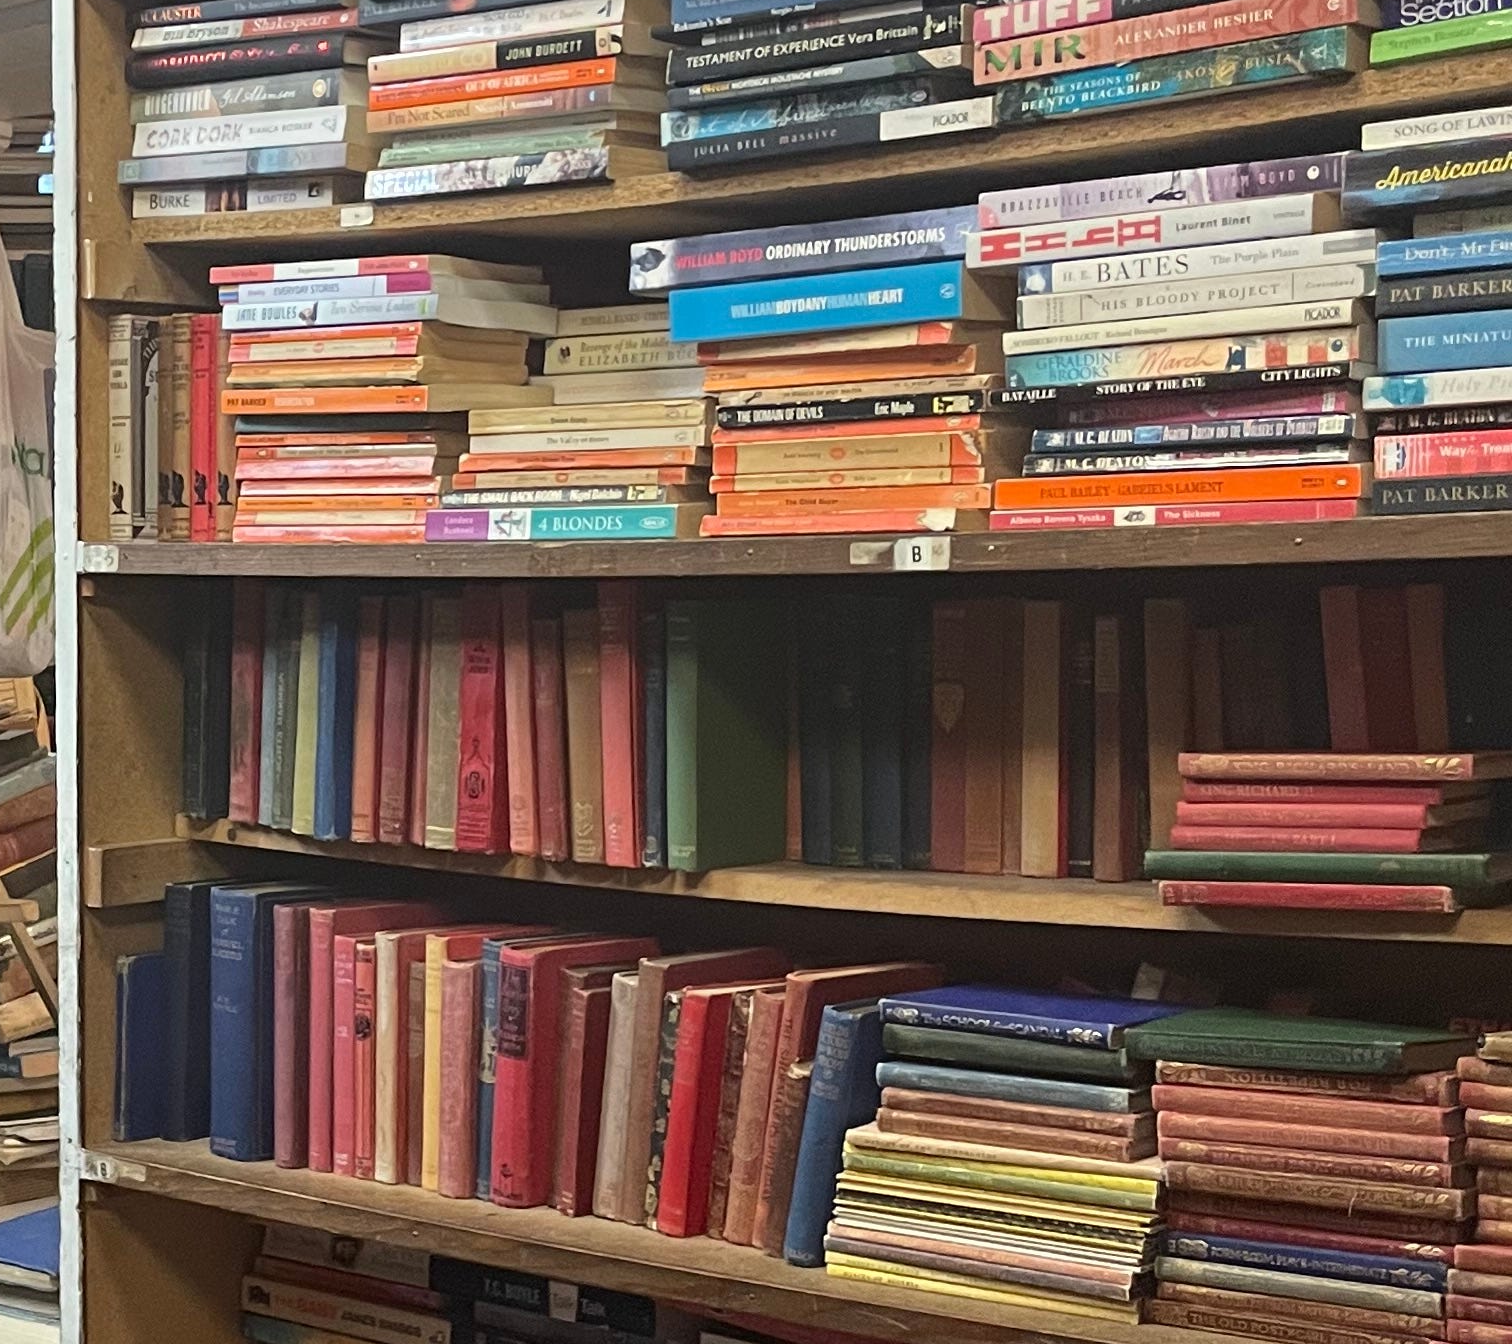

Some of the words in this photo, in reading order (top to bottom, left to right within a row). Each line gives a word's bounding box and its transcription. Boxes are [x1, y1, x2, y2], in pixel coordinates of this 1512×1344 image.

[1115, 19, 1207, 45] ALEXANDER
[1213, 8, 1274, 33] BESHER
[686, 46, 751, 69] TESTAMENT
[755, 44, 770, 58] OF
[773, 33, 845, 57] EXPERIENCE
[847, 28, 873, 45] Vera
[876, 24, 919, 43] Brittain
[983, 36, 1087, 75] MIR
[148, 191, 191, 209] BURKE
[1175, 217, 1219, 231] Laurent
[1222, 213, 1251, 228] Binet
[765, 238, 830, 260] ORDINARY
[834, 227, 945, 253] THUNDERSTORMS
[1096, 254, 1189, 283] BATES
[1100, 298, 1127, 311] HIS
[1208, 283, 1280, 305] PROJECT
[1390, 286, 1426, 302] PAT
[1432, 279, 1511, 299] BARKER
[1261, 369, 1286, 381] CITY
[1289, 365, 1341, 379] LIGHTS
[1095, 381, 1132, 395] STORY
[1134, 381, 1151, 394] OF
[1154, 378, 1179, 391] THE
[1181, 376, 1206, 389] EYE
[1382, 488, 1418, 505] PAT
[1424, 483, 1507, 503] BARKER
[538, 517, 547, 531] 4
[550, 514, 623, 530] BLONDES
